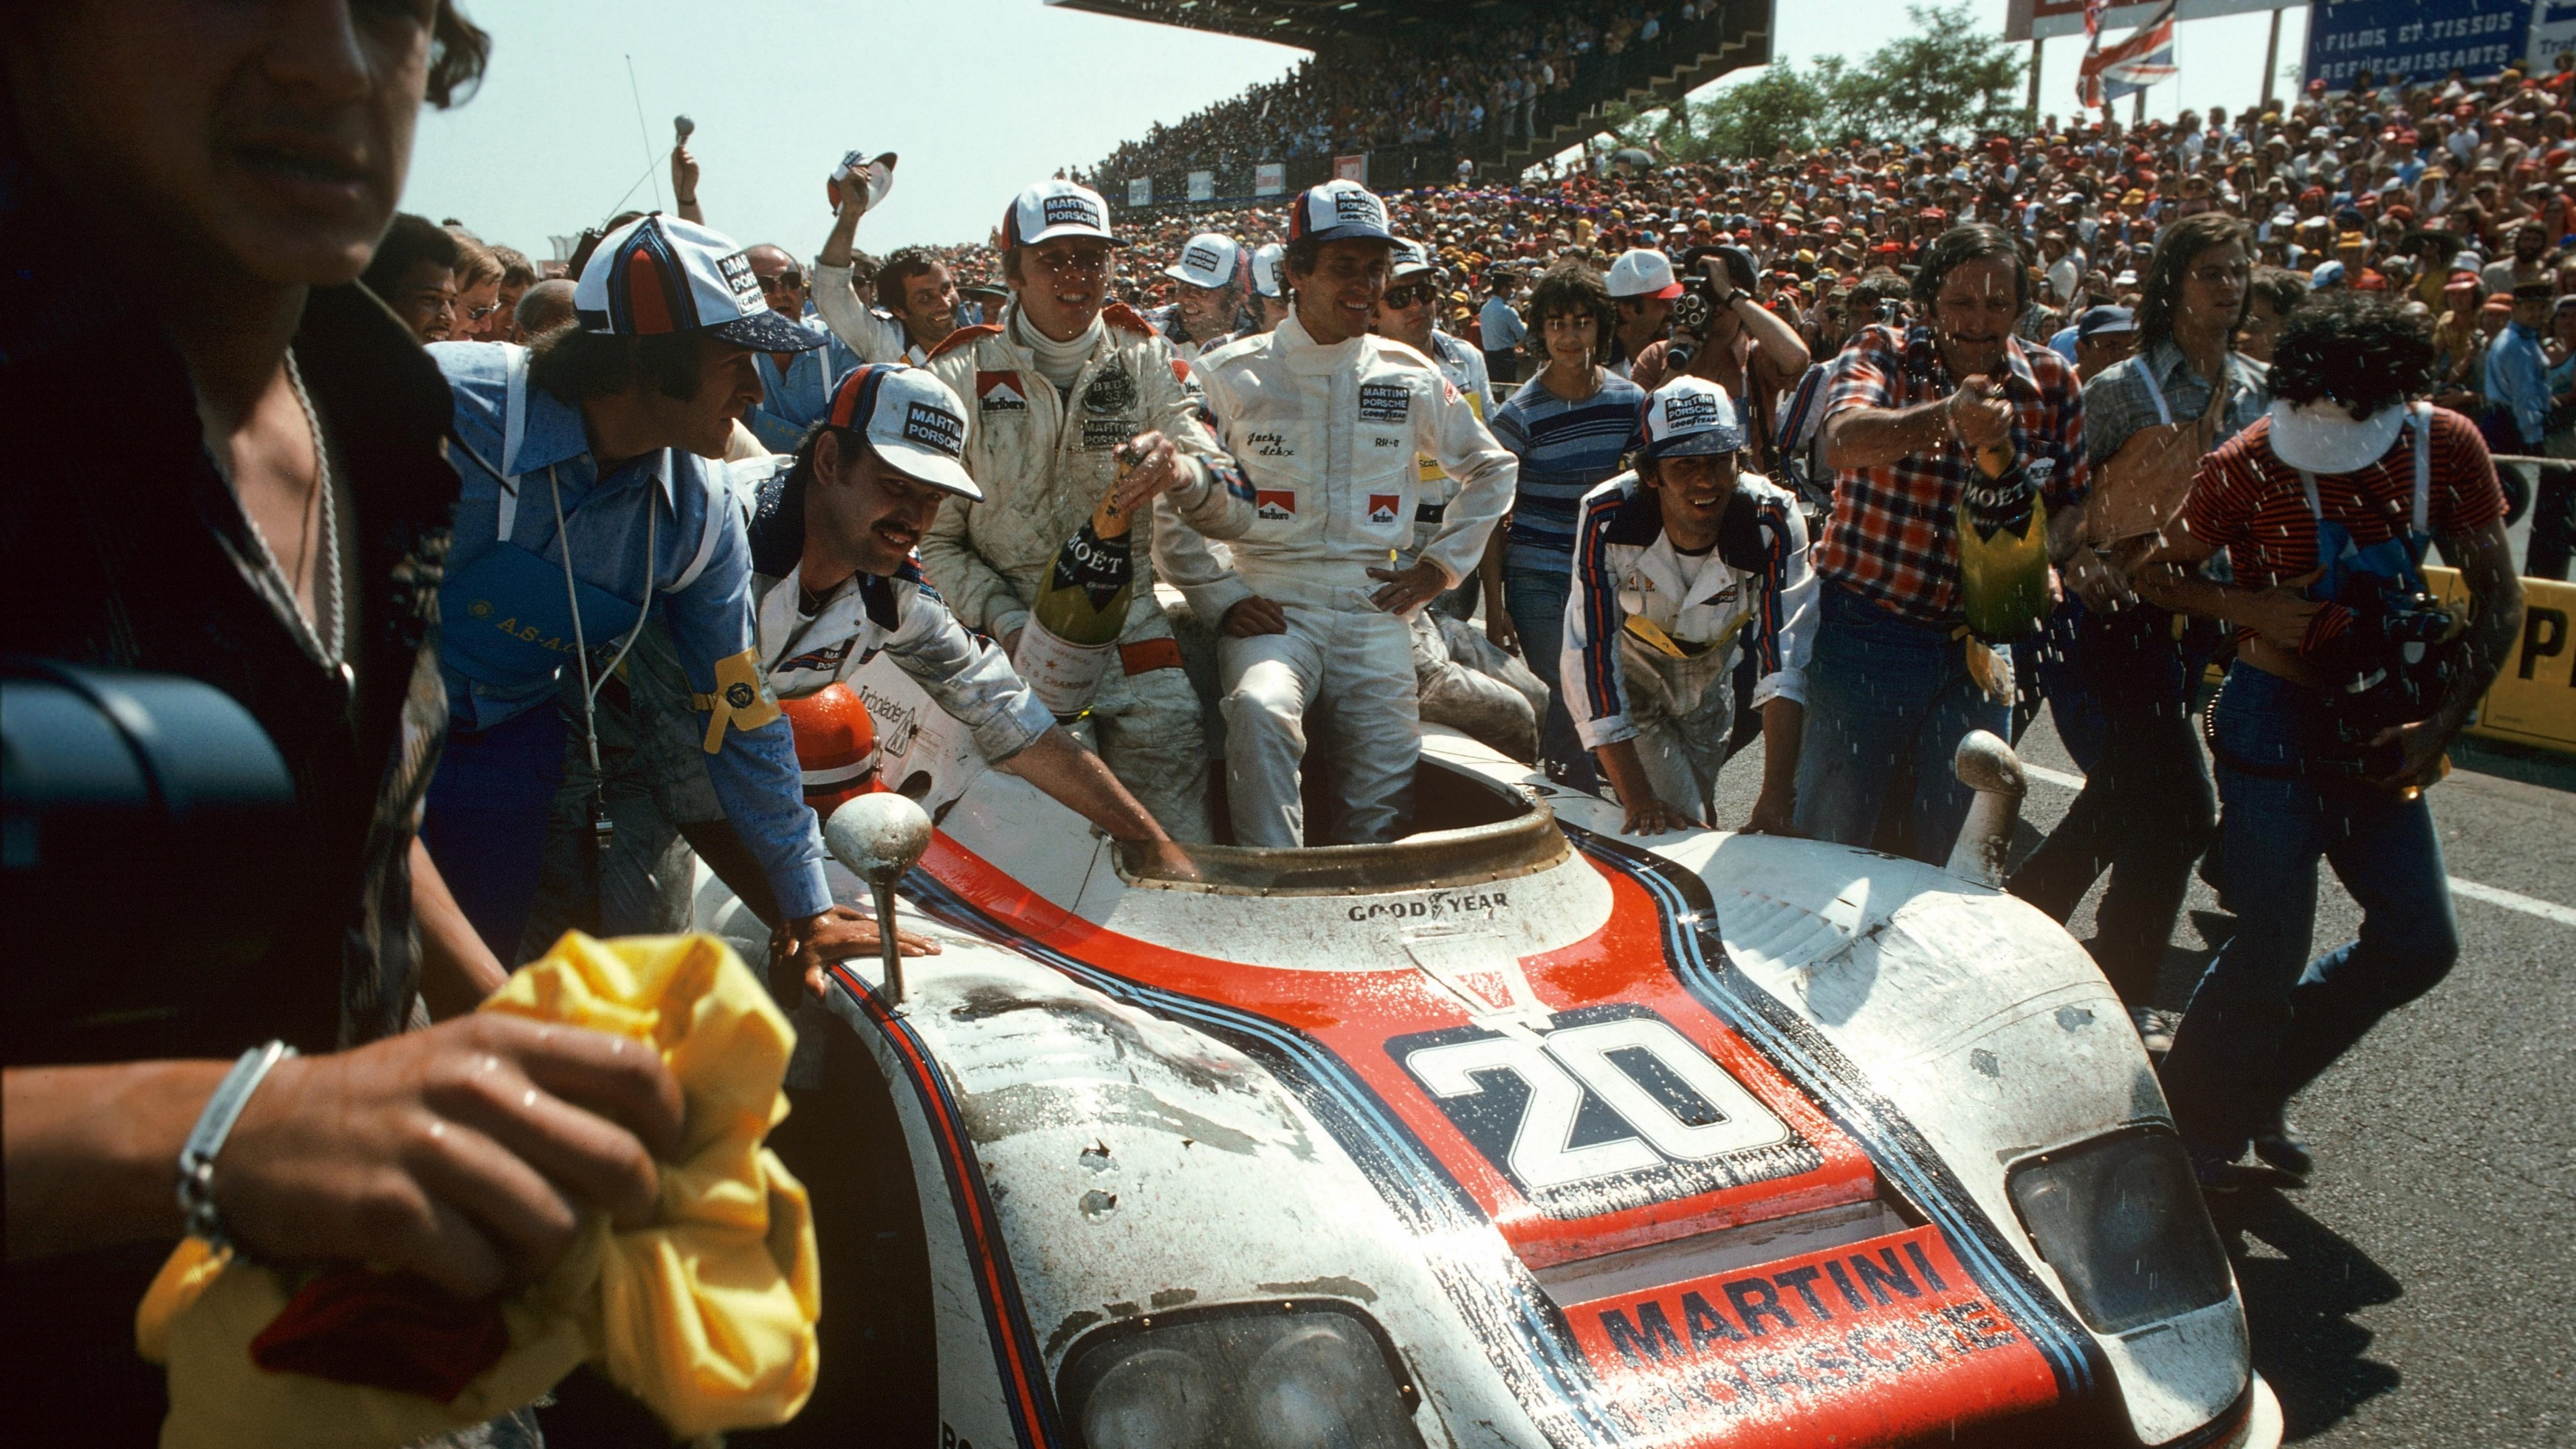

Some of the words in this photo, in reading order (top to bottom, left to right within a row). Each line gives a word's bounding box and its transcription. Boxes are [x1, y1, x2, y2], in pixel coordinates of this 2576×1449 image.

[2326, 28, 2387, 51] FILMS
[2398, 23, 2423, 43] ET
[1363, 387, 1408, 398] MARTINI
[1363, 398, 1407, 408] PORSCHE
[1668, 394, 1714, 409] MARTINI
[1669, 406, 1715, 419] PORSCHE
[1258, 508, 1289, 520] Marlboro
[1068, 532, 1123, 574] MOËT
[2518, 605, 2576, 689] P
[1406, 1017, 1791, 1189] 20
[1598, 1240, 1951, 1368] MARTINI
